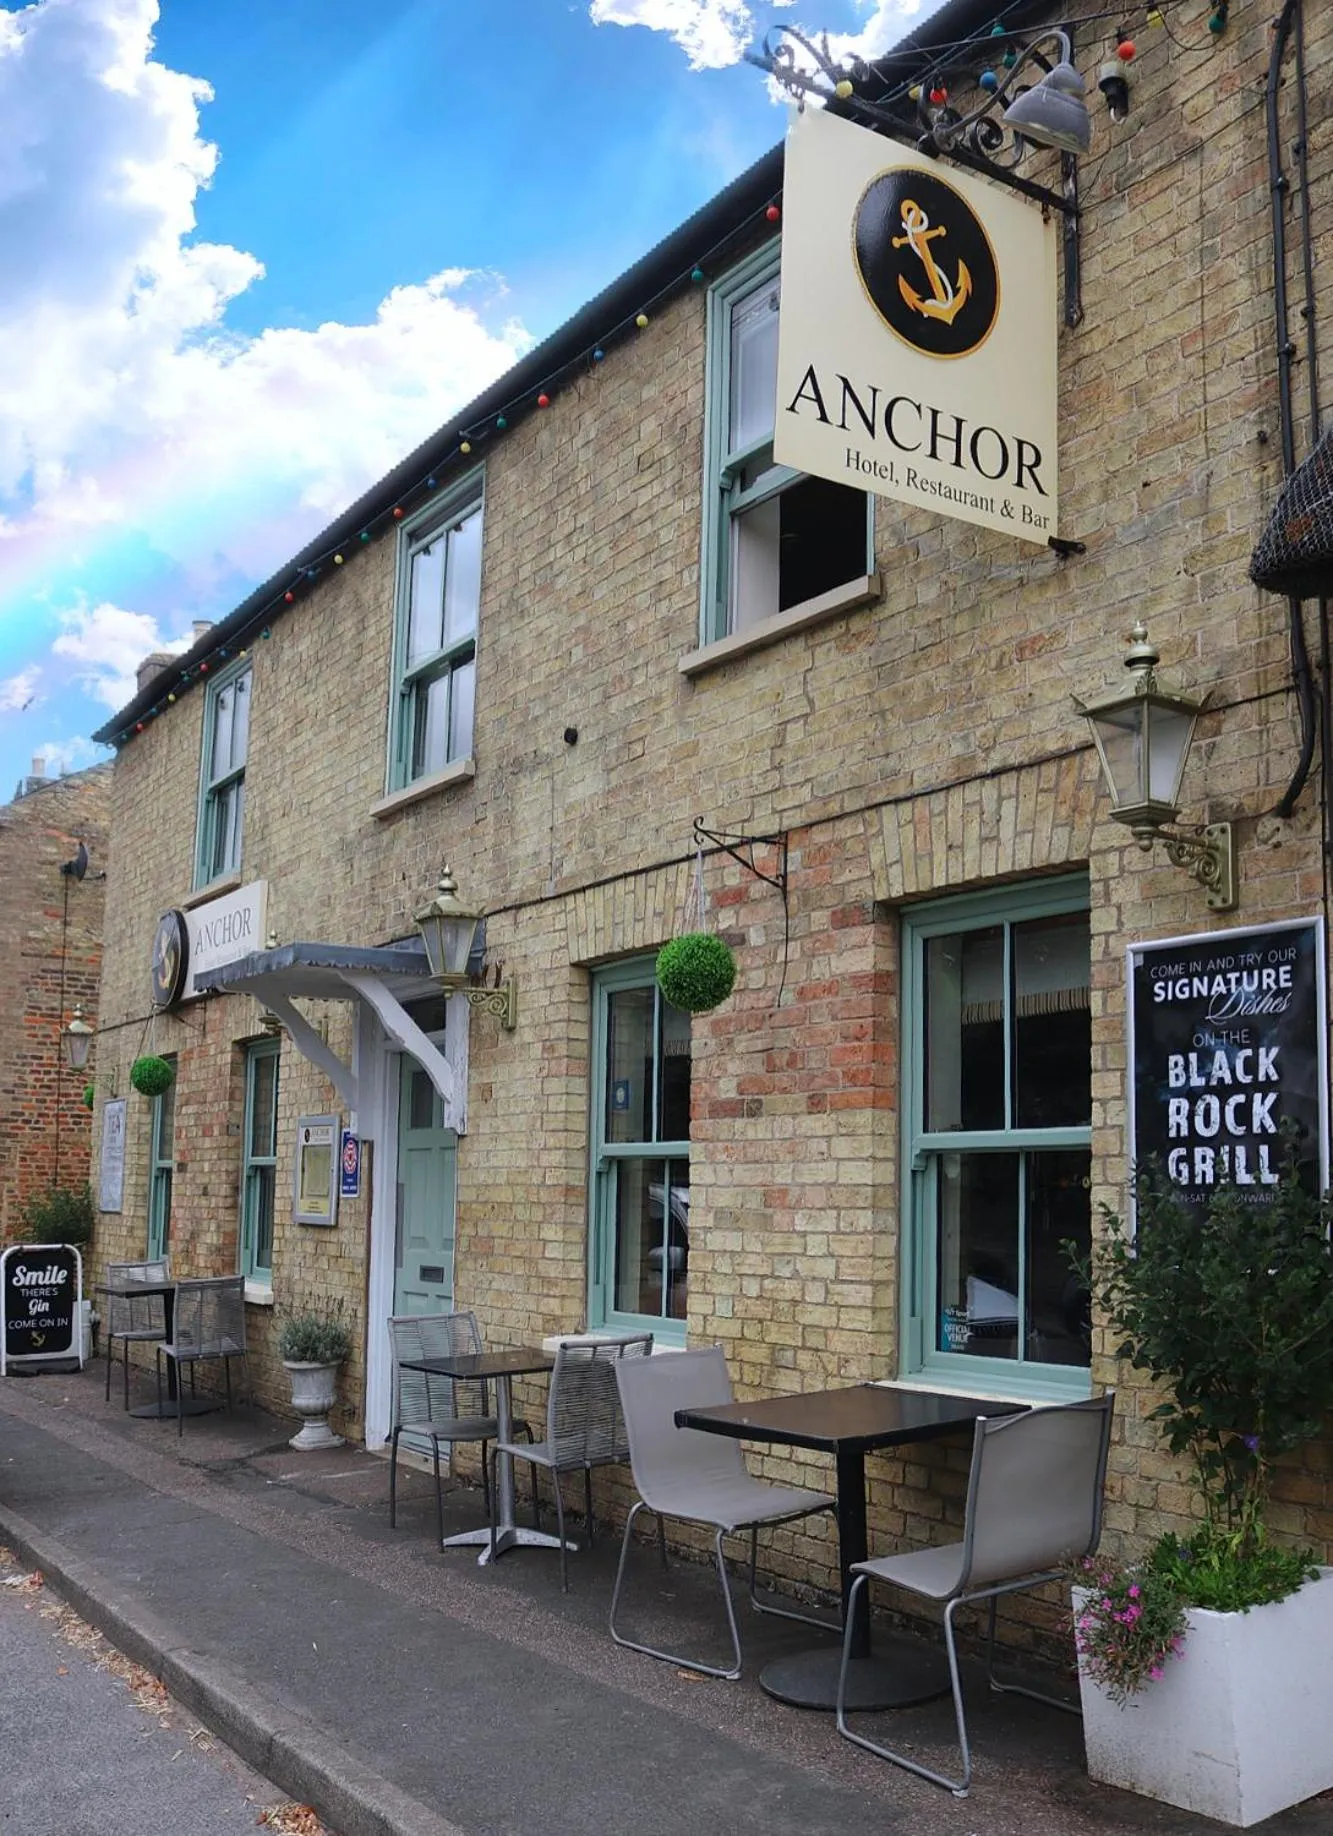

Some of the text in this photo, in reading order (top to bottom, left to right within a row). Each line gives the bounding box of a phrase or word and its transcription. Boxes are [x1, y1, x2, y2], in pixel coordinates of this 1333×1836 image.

[786, 364, 1050, 497] ANCHOR
[846, 448, 1050, 530] Hotel, Restaurant & Bar
[195, 908, 252, 955] ANCHOR
[1150, 948, 1297, 979] COME IN AND TRY OUR
[1153, 965, 1293, 1003] SIGNATURE
[1205, 985, 1292, 1026] Dishes
[1193, 1029, 1250, 1048] ON THE
[1168, 1047, 1281, 1088] BLACK
[1168, 1092, 1278, 1138] ROCK
[1168, 1144, 1280, 1186] GRILL
[12, 1265, 68, 1287] Smile
[8, 1317, 69, 1330] COME ON IN
[28, 1298, 50, 1316] Gin
[944, 1323, 970, 1333] OFFICIAL
